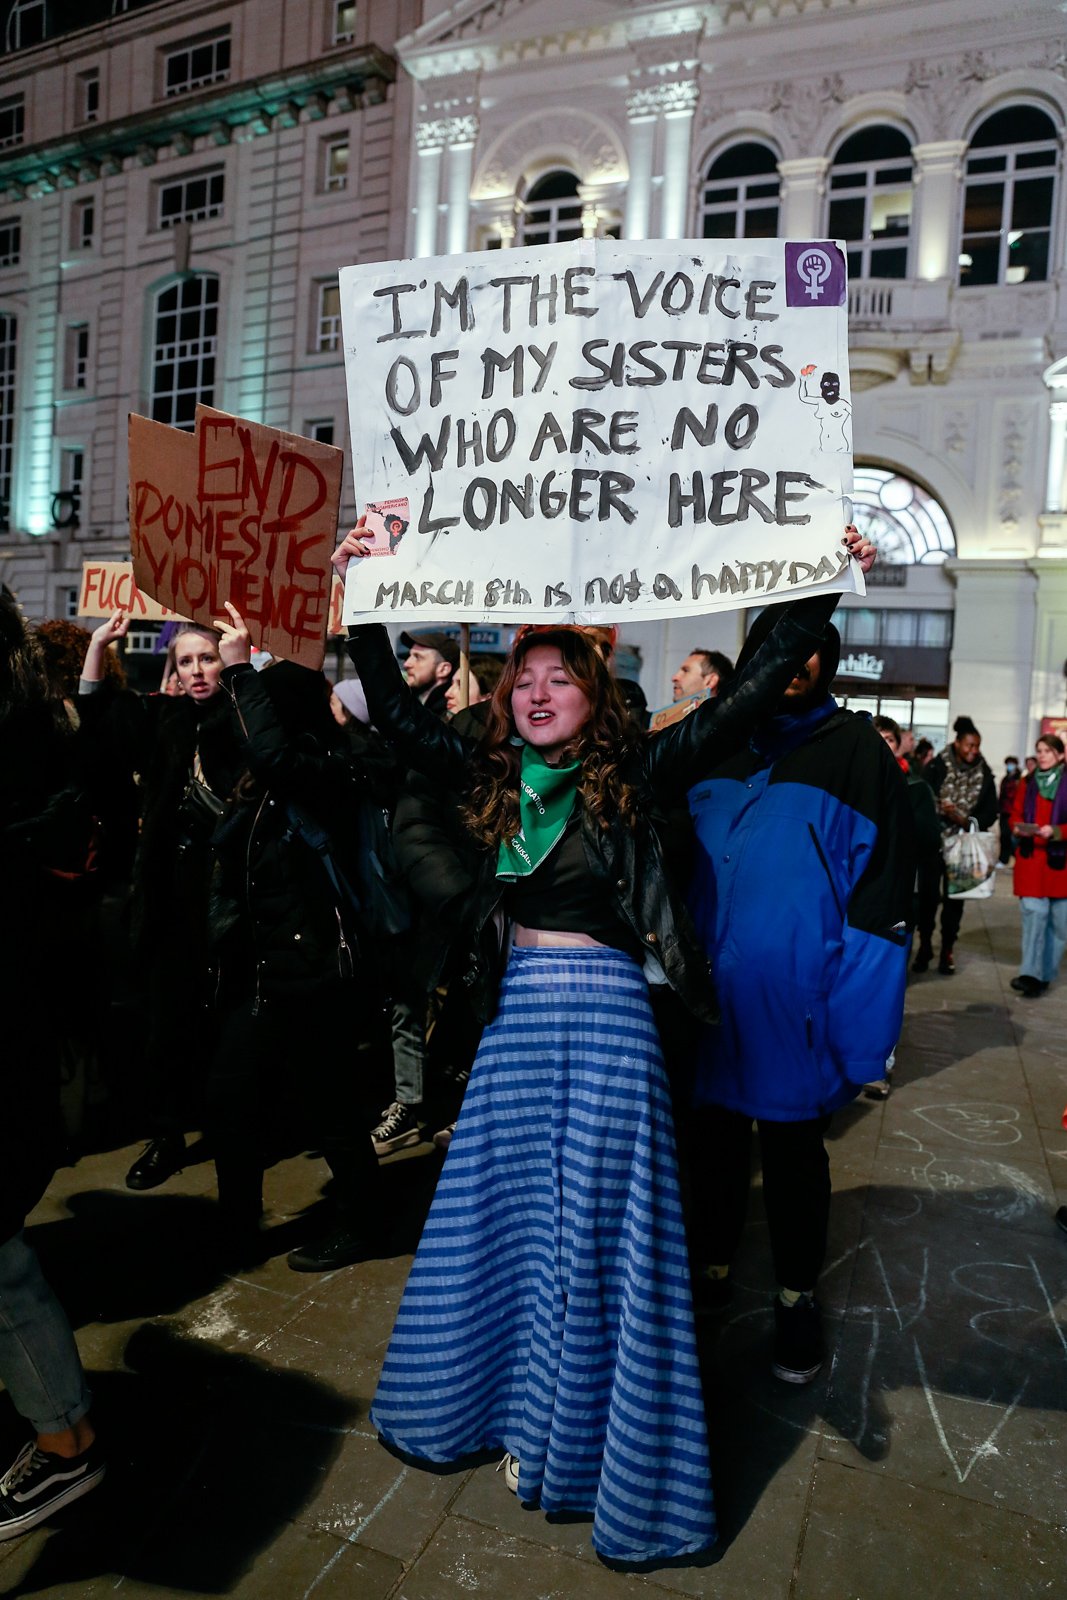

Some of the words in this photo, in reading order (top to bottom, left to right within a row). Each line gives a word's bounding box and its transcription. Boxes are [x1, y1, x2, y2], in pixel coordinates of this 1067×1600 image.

[373, 275, 475, 343] I'M
[489, 267, 599, 334] THE
[622, 269, 780, 322] VOICE
[385, 349, 460, 417] OF
[480, 341, 558, 400] MY
[569, 338, 797, 391] SISTERS
[197, 416, 328, 533] END
[390, 407, 517, 476] WHO
[529, 407, 642, 462] ARE
[671, 403, 760, 451] NO
[135, 480, 327, 578] DOMESTIC
[418, 468, 639, 535] LONGER
[668, 468, 815, 529] HERE
[375, 579, 474, 608] MARCH
[484, 577, 532, 608] 8th
[585, 568, 646, 605] not
